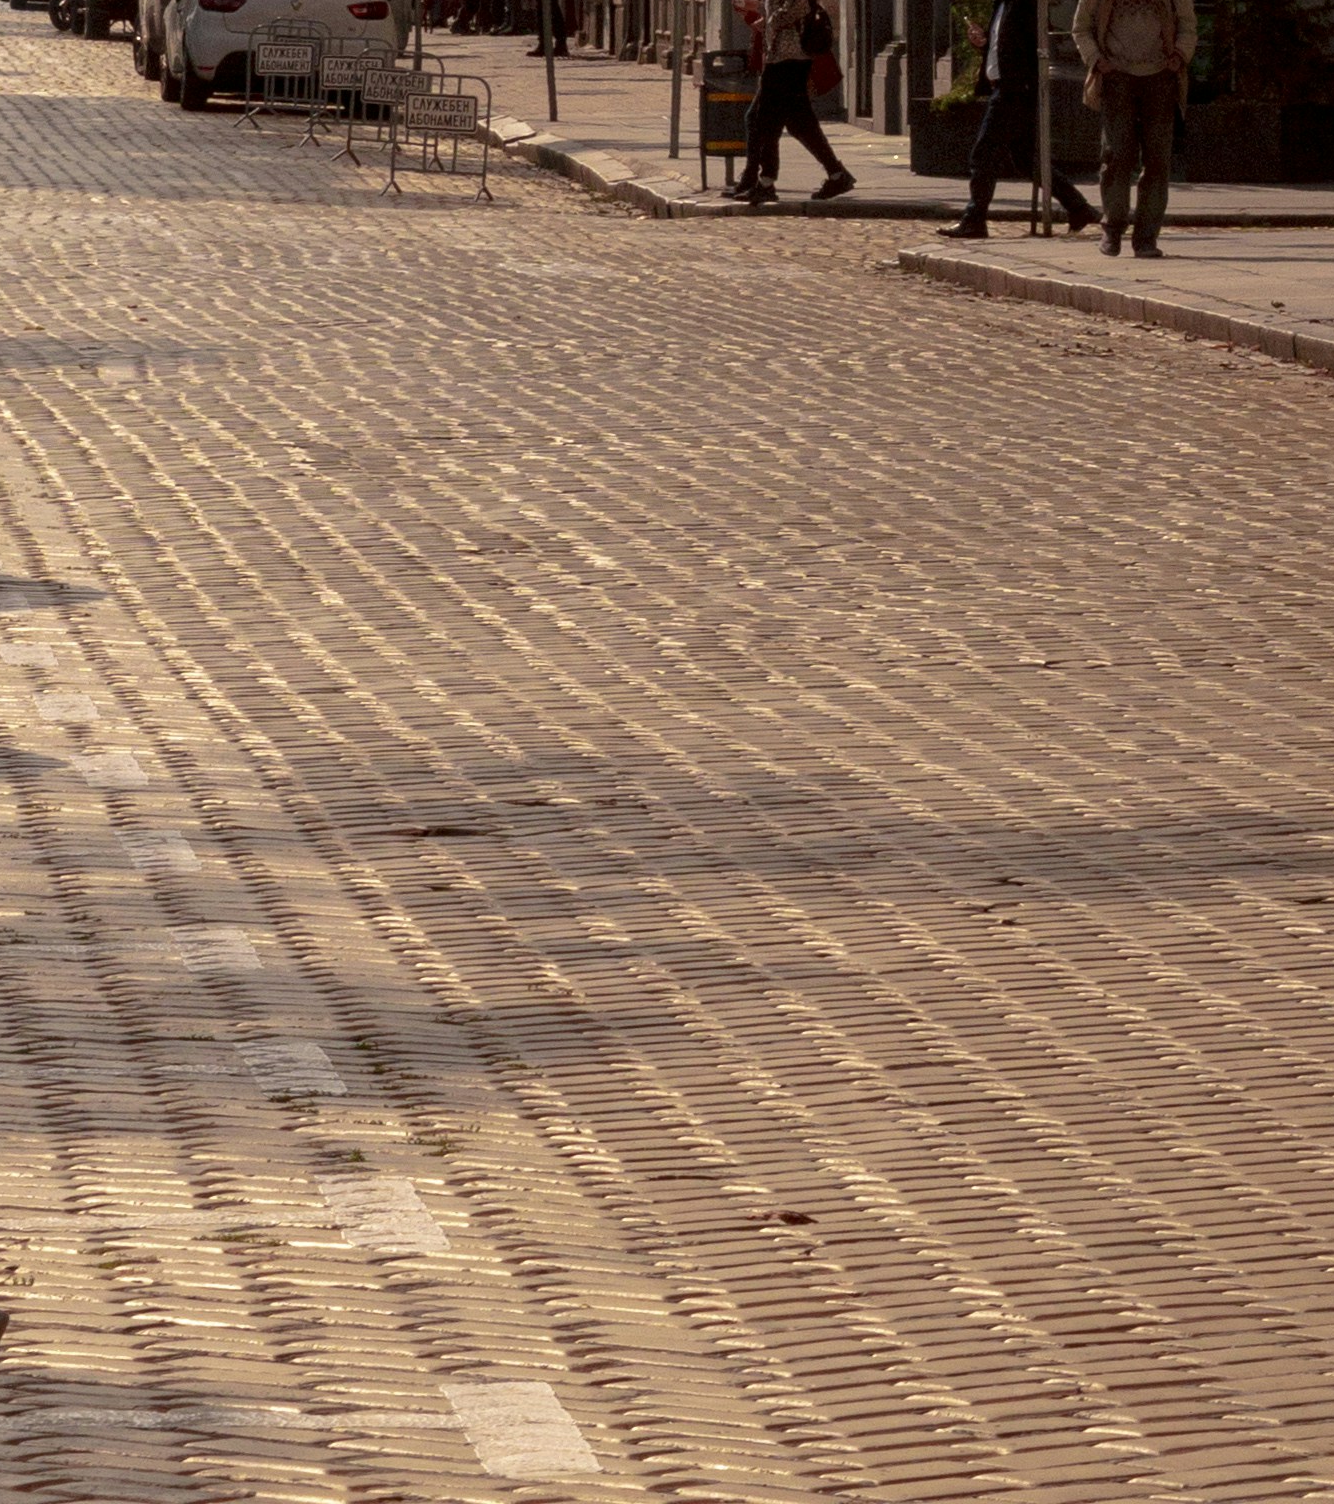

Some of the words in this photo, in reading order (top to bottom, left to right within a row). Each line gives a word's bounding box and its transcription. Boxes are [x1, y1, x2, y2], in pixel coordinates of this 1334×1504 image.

[262, 46, 308, 58] СЛУЖЕБЕН
[260, 59, 312, 71] АБОНАМЕНТ
[412, 97, 470, 112] СЛУЖЕБЕН
[409, 113, 473, 128] АБОНАМЕНТ
